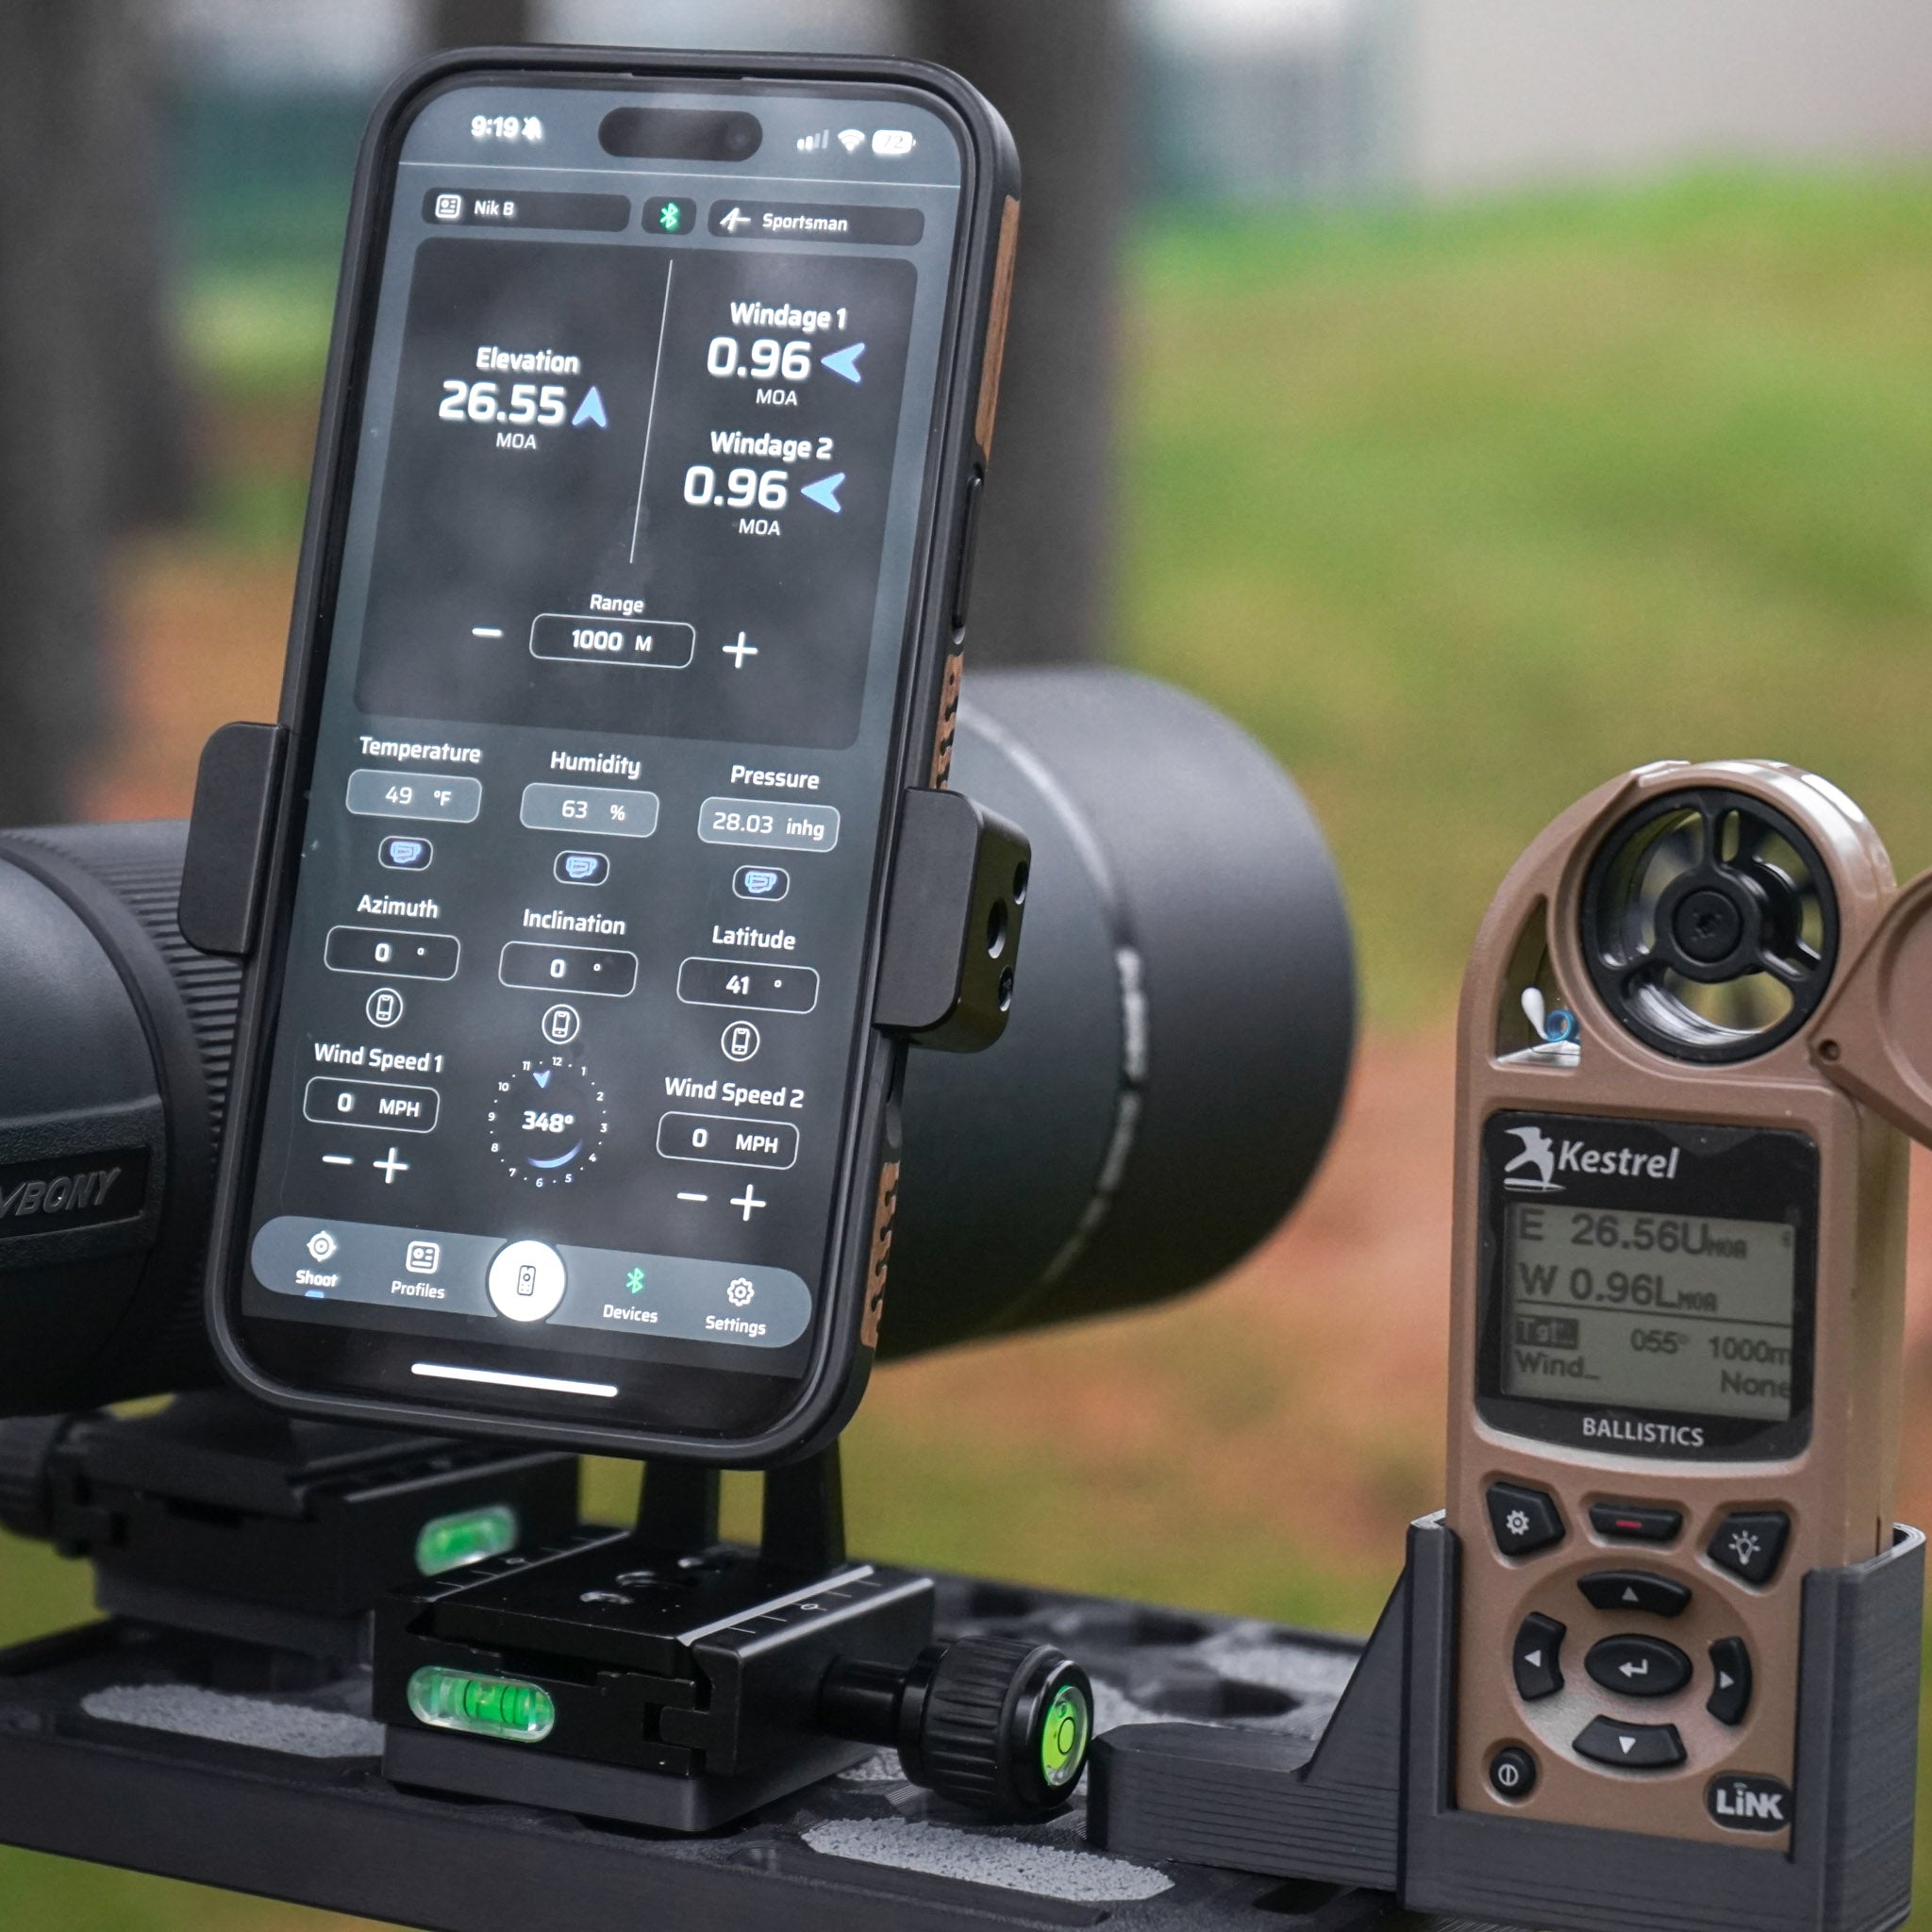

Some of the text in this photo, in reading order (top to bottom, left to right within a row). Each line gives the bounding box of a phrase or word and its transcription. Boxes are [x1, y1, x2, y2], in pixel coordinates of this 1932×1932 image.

[471, 116, 519, 140] 9:19
[882, 134, 905, 151] 72
[475, 199, 514, 216] Nik B
[762, 212, 848, 233] Sportsman
[730, 303, 846, 331] Windage 1
[475, 346, 579, 375] Elevation
[707, 336, 811, 380] 0.96
[439, 380, 566, 425] 26.55
[756, 388, 798, 407] MOA
[495, 432, 537, 450] MOA
[710, 431, 832, 463] Windage 2
[683, 465, 789, 509] 0.96
[739, 519, 781, 537] MOA
[590, 593, 644, 615] Range
[572, 629, 653, 652] 1000 M
[359, 737, 481, 764] Temperature
[550, 752, 641, 779] Humidity
[730, 766, 820, 791] Pressure
[386, 787, 412, 805] 49
[561, 801, 626, 822] 63 %
[712, 812, 824, 841] 28.03 inhg
[358, 894, 439, 919] Azimuth
[523, 908, 626, 936] Inclination
[712, 925, 796, 950] Latitude
[725, 976, 750, 995] 41
[313, 1043, 442, 1073] Wind Speed 1
[523, 1061, 530, 1071] 11
[552, 1057, 562, 1067] 12
[581, 1066, 586, 1076] 1
[498, 1081, 509, 1092] 10
[596, 1091, 604, 1102] 2
[664, 1077, 805, 1108] Wind Speed 2
[378, 1098, 421, 1117] MPH
[488, 1112, 495, 1122] 9
[600, 1123, 608, 1133] 3
[491, 1142, 498, 1153] 8
[735, 1134, 779, 1154] MPH
[588, 1152, 597, 1162] 4
[1558, 1140, 1680, 1179] Kestrel
[509, 1167, 516, 1177] 7
[536, 1177, 542, 1188] 6
[565, 1174, 572, 1183] 5
[1518, 1208, 1545, 1241] E
[295, 1269, 338, 1288] Shoot
[1518, 1261, 1558, 1296] W
[391, 1280, 445, 1300] Profiles
[602, 1304, 658, 1324] Devices
[705, 1315, 766, 1337] Settings
[1583, 1417, 1705, 1447] BALLISTICS
